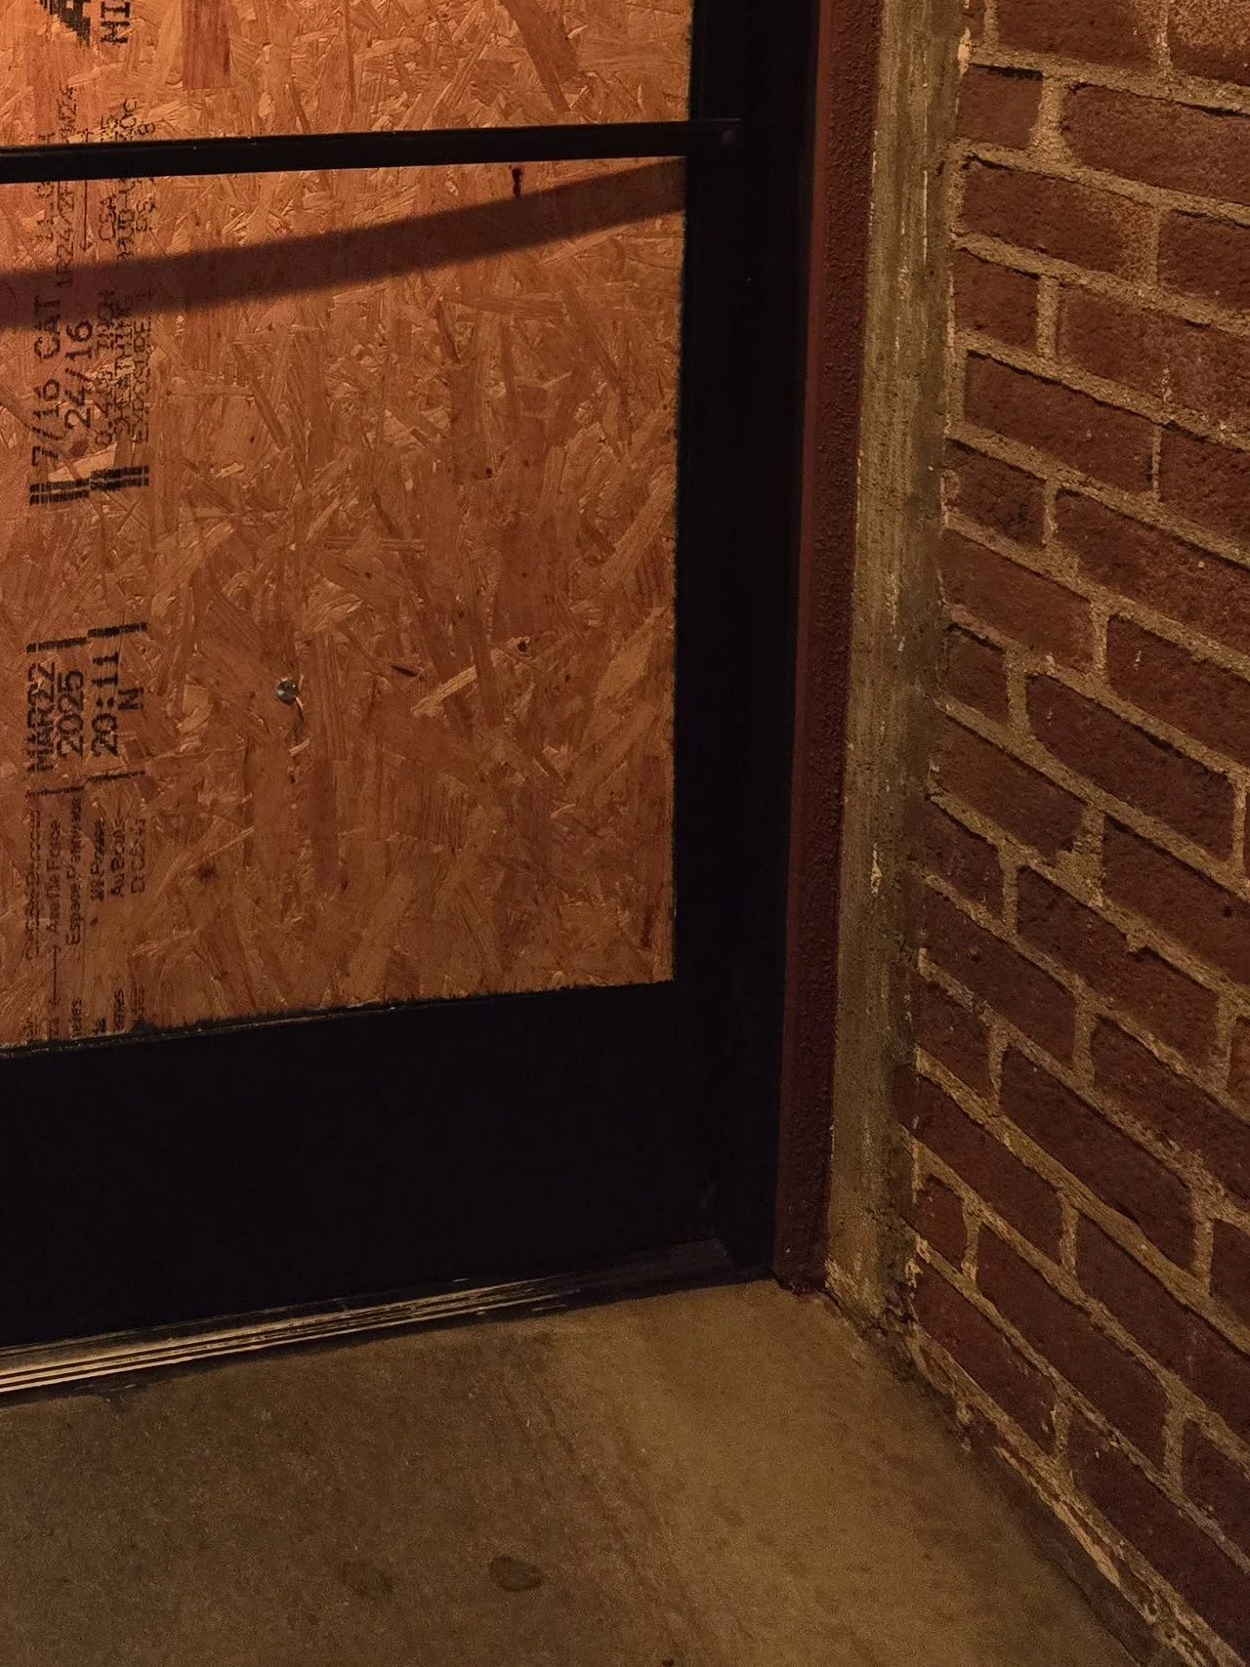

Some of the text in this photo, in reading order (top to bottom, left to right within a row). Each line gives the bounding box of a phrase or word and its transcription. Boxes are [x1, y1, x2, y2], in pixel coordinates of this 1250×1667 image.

[31, 295, 62, 466] 7/16 CAT
[63, 321, 93, 430] 24/16
[26, 661, 55, 773] MAR22
[56, 670, 84, 758] 2025
[91, 651, 118, 757] 20:11
[117, 687, 143, 711] N
[66, 883, 85, 946] Espace
